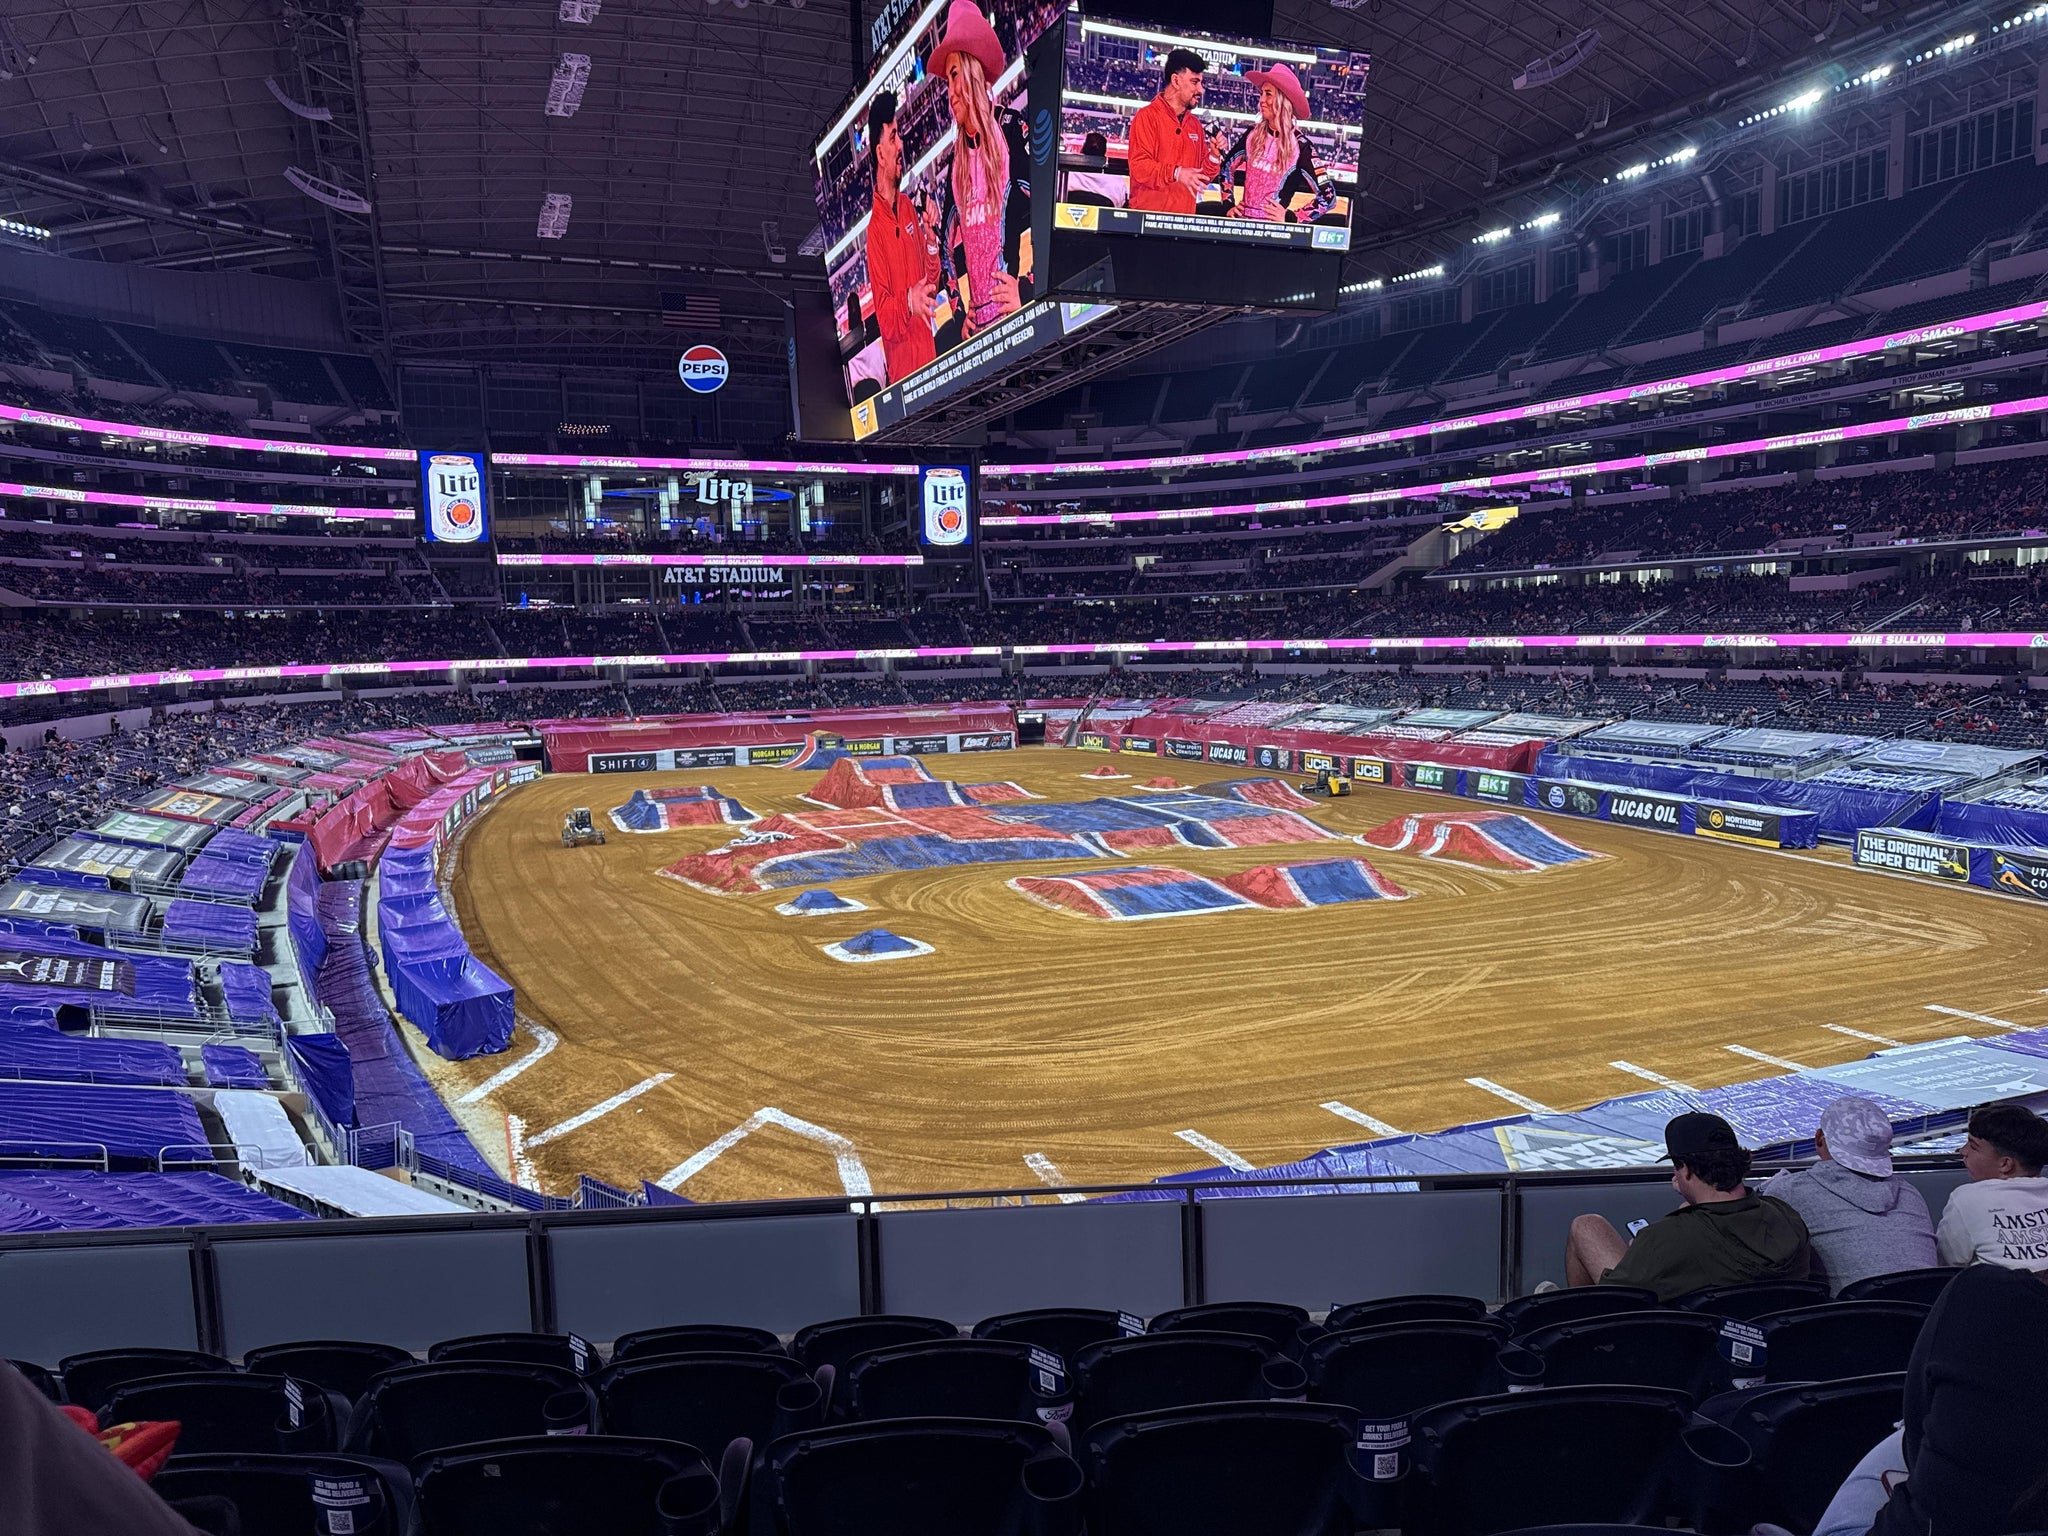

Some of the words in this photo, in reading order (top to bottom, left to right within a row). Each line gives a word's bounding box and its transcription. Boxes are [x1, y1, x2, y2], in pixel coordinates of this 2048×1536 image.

[1197, 49, 1237, 64] STADIUM
[682, 363, 725, 374] PEPSI
[1745, 362, 1772, 374] JAMIE
[1774, 352, 1821, 368] SULLIVAN
[1898, 376, 1916, 384] TROY
[1917, 370, 1946, 380] AIKMAN
[1522, 405, 1545, 416] JAMIE
[1548, 398, 1582, 412] SULLIVAN
[1764, 398, 1790, 408] MICHAEL
[1792, 395, 1808, 404] IRVIN
[1638, 419, 1660, 428] CHARLES
[1662, 416, 1682, 424] HALEY
[1906, 412, 1947, 429] Sparkle
[1947, 406, 1992, 420] SMASH
[138, 429, 164, 438] JAMIE
[166, 432, 209, 443] SULLIVAN
[1339, 438, 1360, 446] JAMIE
[1361, 432, 1391, 443] SULLIVAN
[1766, 440, 1794, 449] JAMIE
[1796, 431, 1844, 445] SULLIVAN
[384, 449, 410, 458] JAMIE
[688, 460, 712, 468] JAMIE
[713, 461, 750, 469] SULLIVAN
[1538, 472, 1558, 480] JAMIE
[1560, 466, 1597, 478] SULLIVAN
[436, 472, 478, 497] Lite
[696, 477, 748, 504] Lite
[932, 483, 965, 506] Lite
[144, 500, 170, 508] JAMIE
[172, 502, 217, 512] SULLIVAN
[664, 568, 706, 583] AT&T
[710, 567, 784, 583] STADIUM
[1576, 637, 1602, 646] JAMIE
[1604, 636, 1646, 646] SULLIVAN
[1848, 636, 1882, 644] JAMIE
[1884, 635, 1946, 645] SULLIVAN
[450, 660, 476, 668] JAMIE
[478, 660, 528, 668] SULLIVAN
[224, 670, 246, 678] JAMIE
[247, 667, 281, 678] SULLIVAN
[1084, 734, 1104, 746] UNOH
[480, 754, 513, 762] COMMISSION
[752, 749, 774, 758] MORGAN
[776, 748, 780, 756] &
[1176, 748, 1202, 756] COMMISSION
[1209, 746, 1232, 760] LUCAS
[1233, 748, 1246, 761] OIL
[600, 758, 636, 770] SHIFT
[1306, 758, 1329, 770] JCB
[1356, 764, 1381, 778] JCB
[1416, 768, 1444, 782] BKT
[1478, 776, 1510, 792] BKT
[1610, 798, 1653, 820] LUCAS
[1725, 815, 1763, 828] NORTHERN
[1862, 836, 1886, 850] THE
[1860, 849, 1902, 868] SUPER
[1905, 856, 1940, 874] GLUE
[1365, 1424, 1376, 1432] GET
[1376, 1424, 1390, 1432] YOUR
[1391, 1421, 1402, 1432] FOOD
[1362, 1432, 1382, 1440] DRINKS
[314, 1486, 331, 1496] DRINKS
[315, 1480, 324, 1488] GET
[324, 1482, 338, 1490] YOUR
[338, 1482, 354, 1490] FOOD
